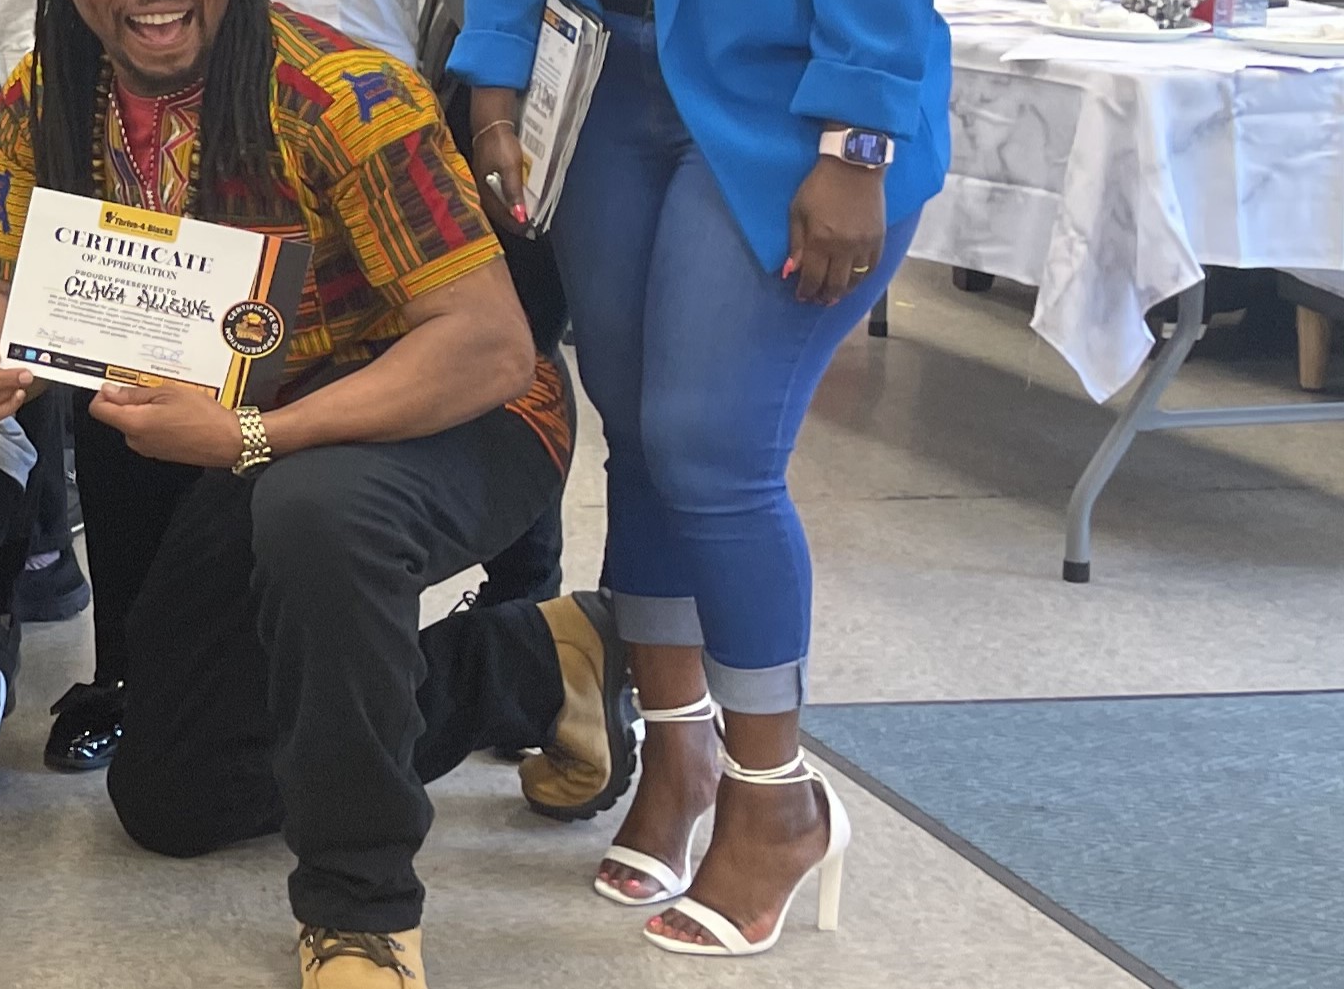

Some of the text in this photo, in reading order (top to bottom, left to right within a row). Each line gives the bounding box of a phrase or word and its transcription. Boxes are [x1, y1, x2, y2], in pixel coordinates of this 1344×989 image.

[55, 227, 214, 274] CERTIFICATE
[81, 252, 178, 280] OF APPRECIATION
[74, 269, 177, 296] PROUDLY PRESENTED TO
[227, 304, 276, 323] CERTIFICATE
